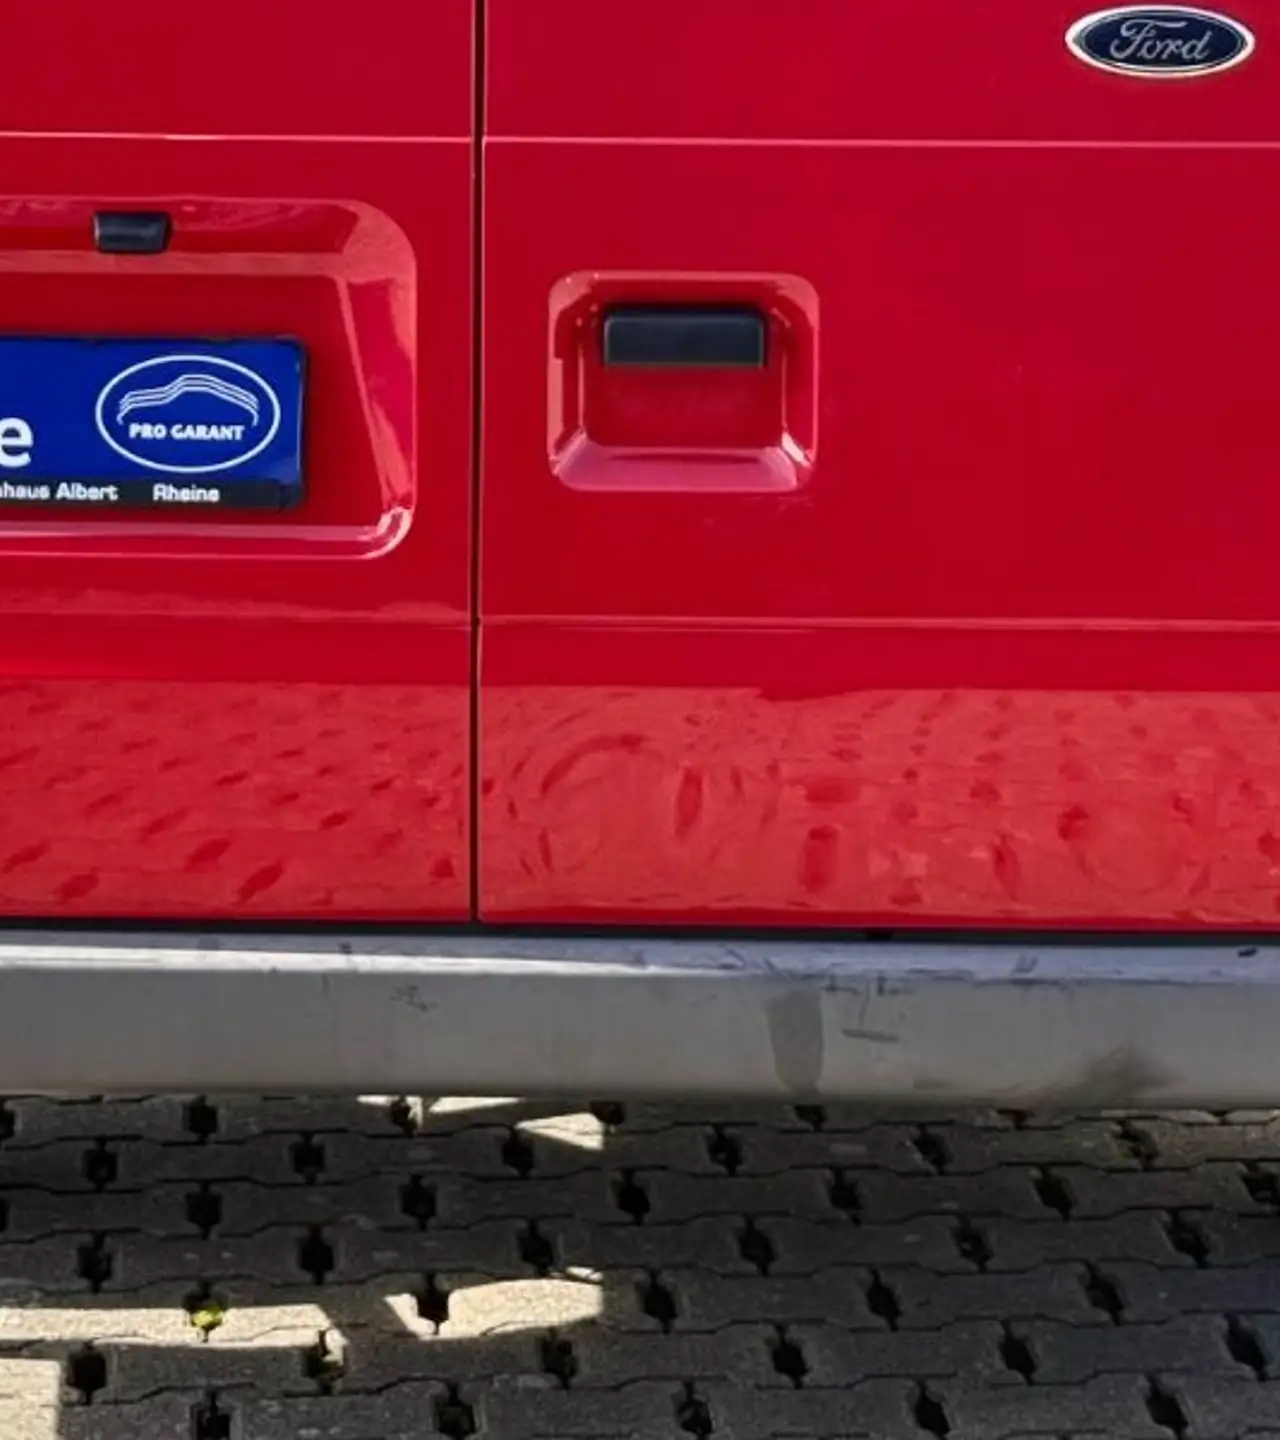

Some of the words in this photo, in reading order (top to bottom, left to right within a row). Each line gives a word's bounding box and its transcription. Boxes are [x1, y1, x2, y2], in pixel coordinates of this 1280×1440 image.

[1109, 18, 1212, 60] Ford
[128, 422, 167, 439] PRO
[170, 423, 245, 441] GARANT
[56, 482, 119, 501] Albert
